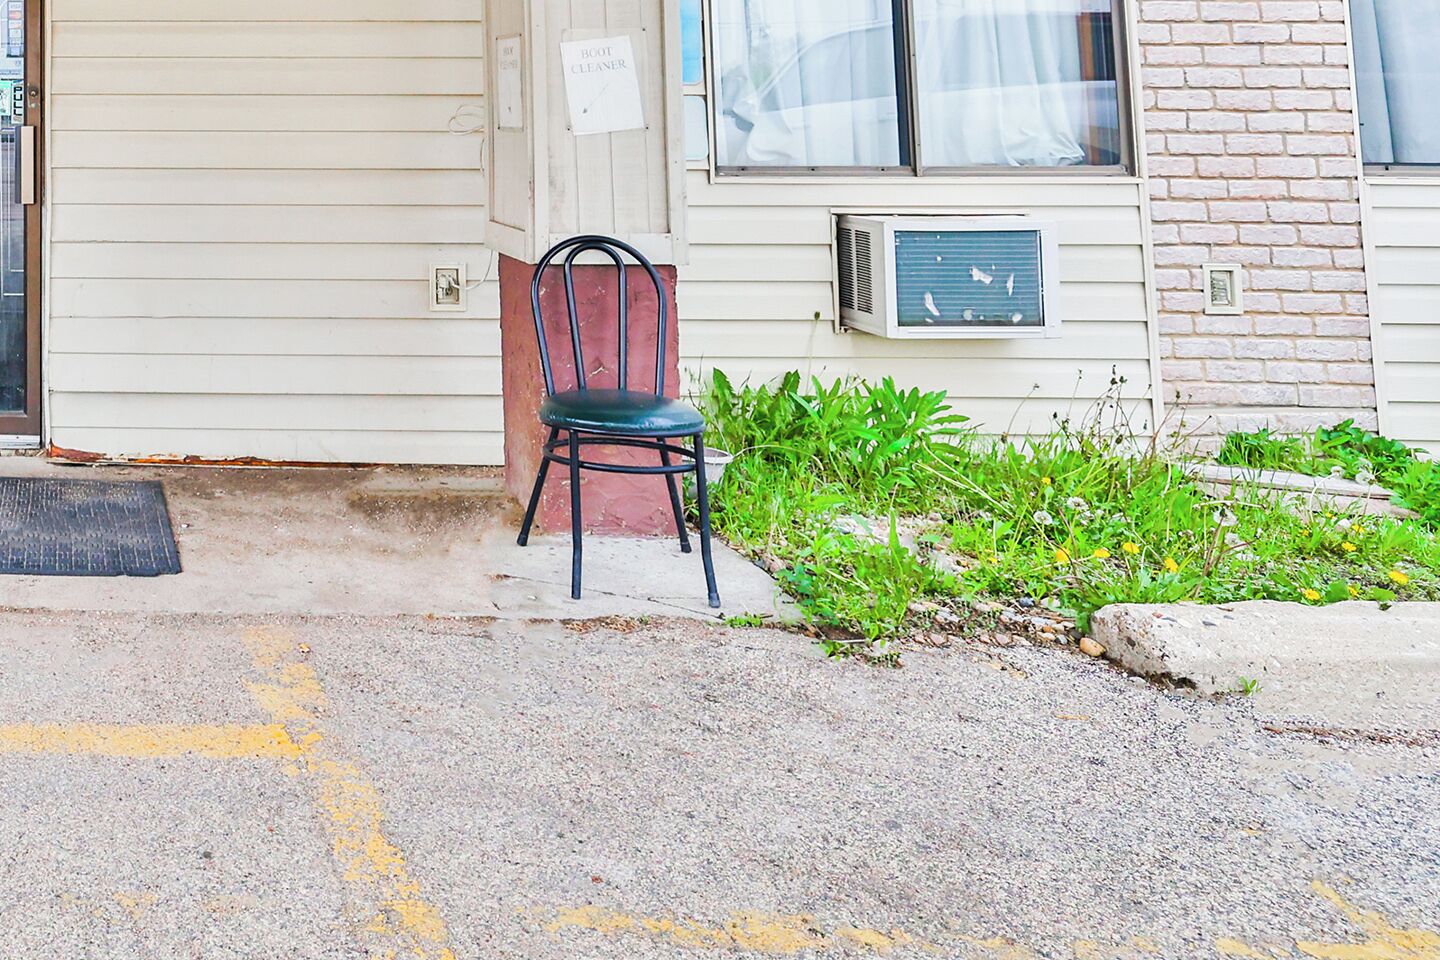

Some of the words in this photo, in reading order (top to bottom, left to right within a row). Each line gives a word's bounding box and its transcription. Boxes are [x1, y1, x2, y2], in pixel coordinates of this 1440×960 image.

[581, 46, 614, 59] BOOT
[571, 59, 627, 74] CLEANER
[13, 86, 23, 117] PULL
